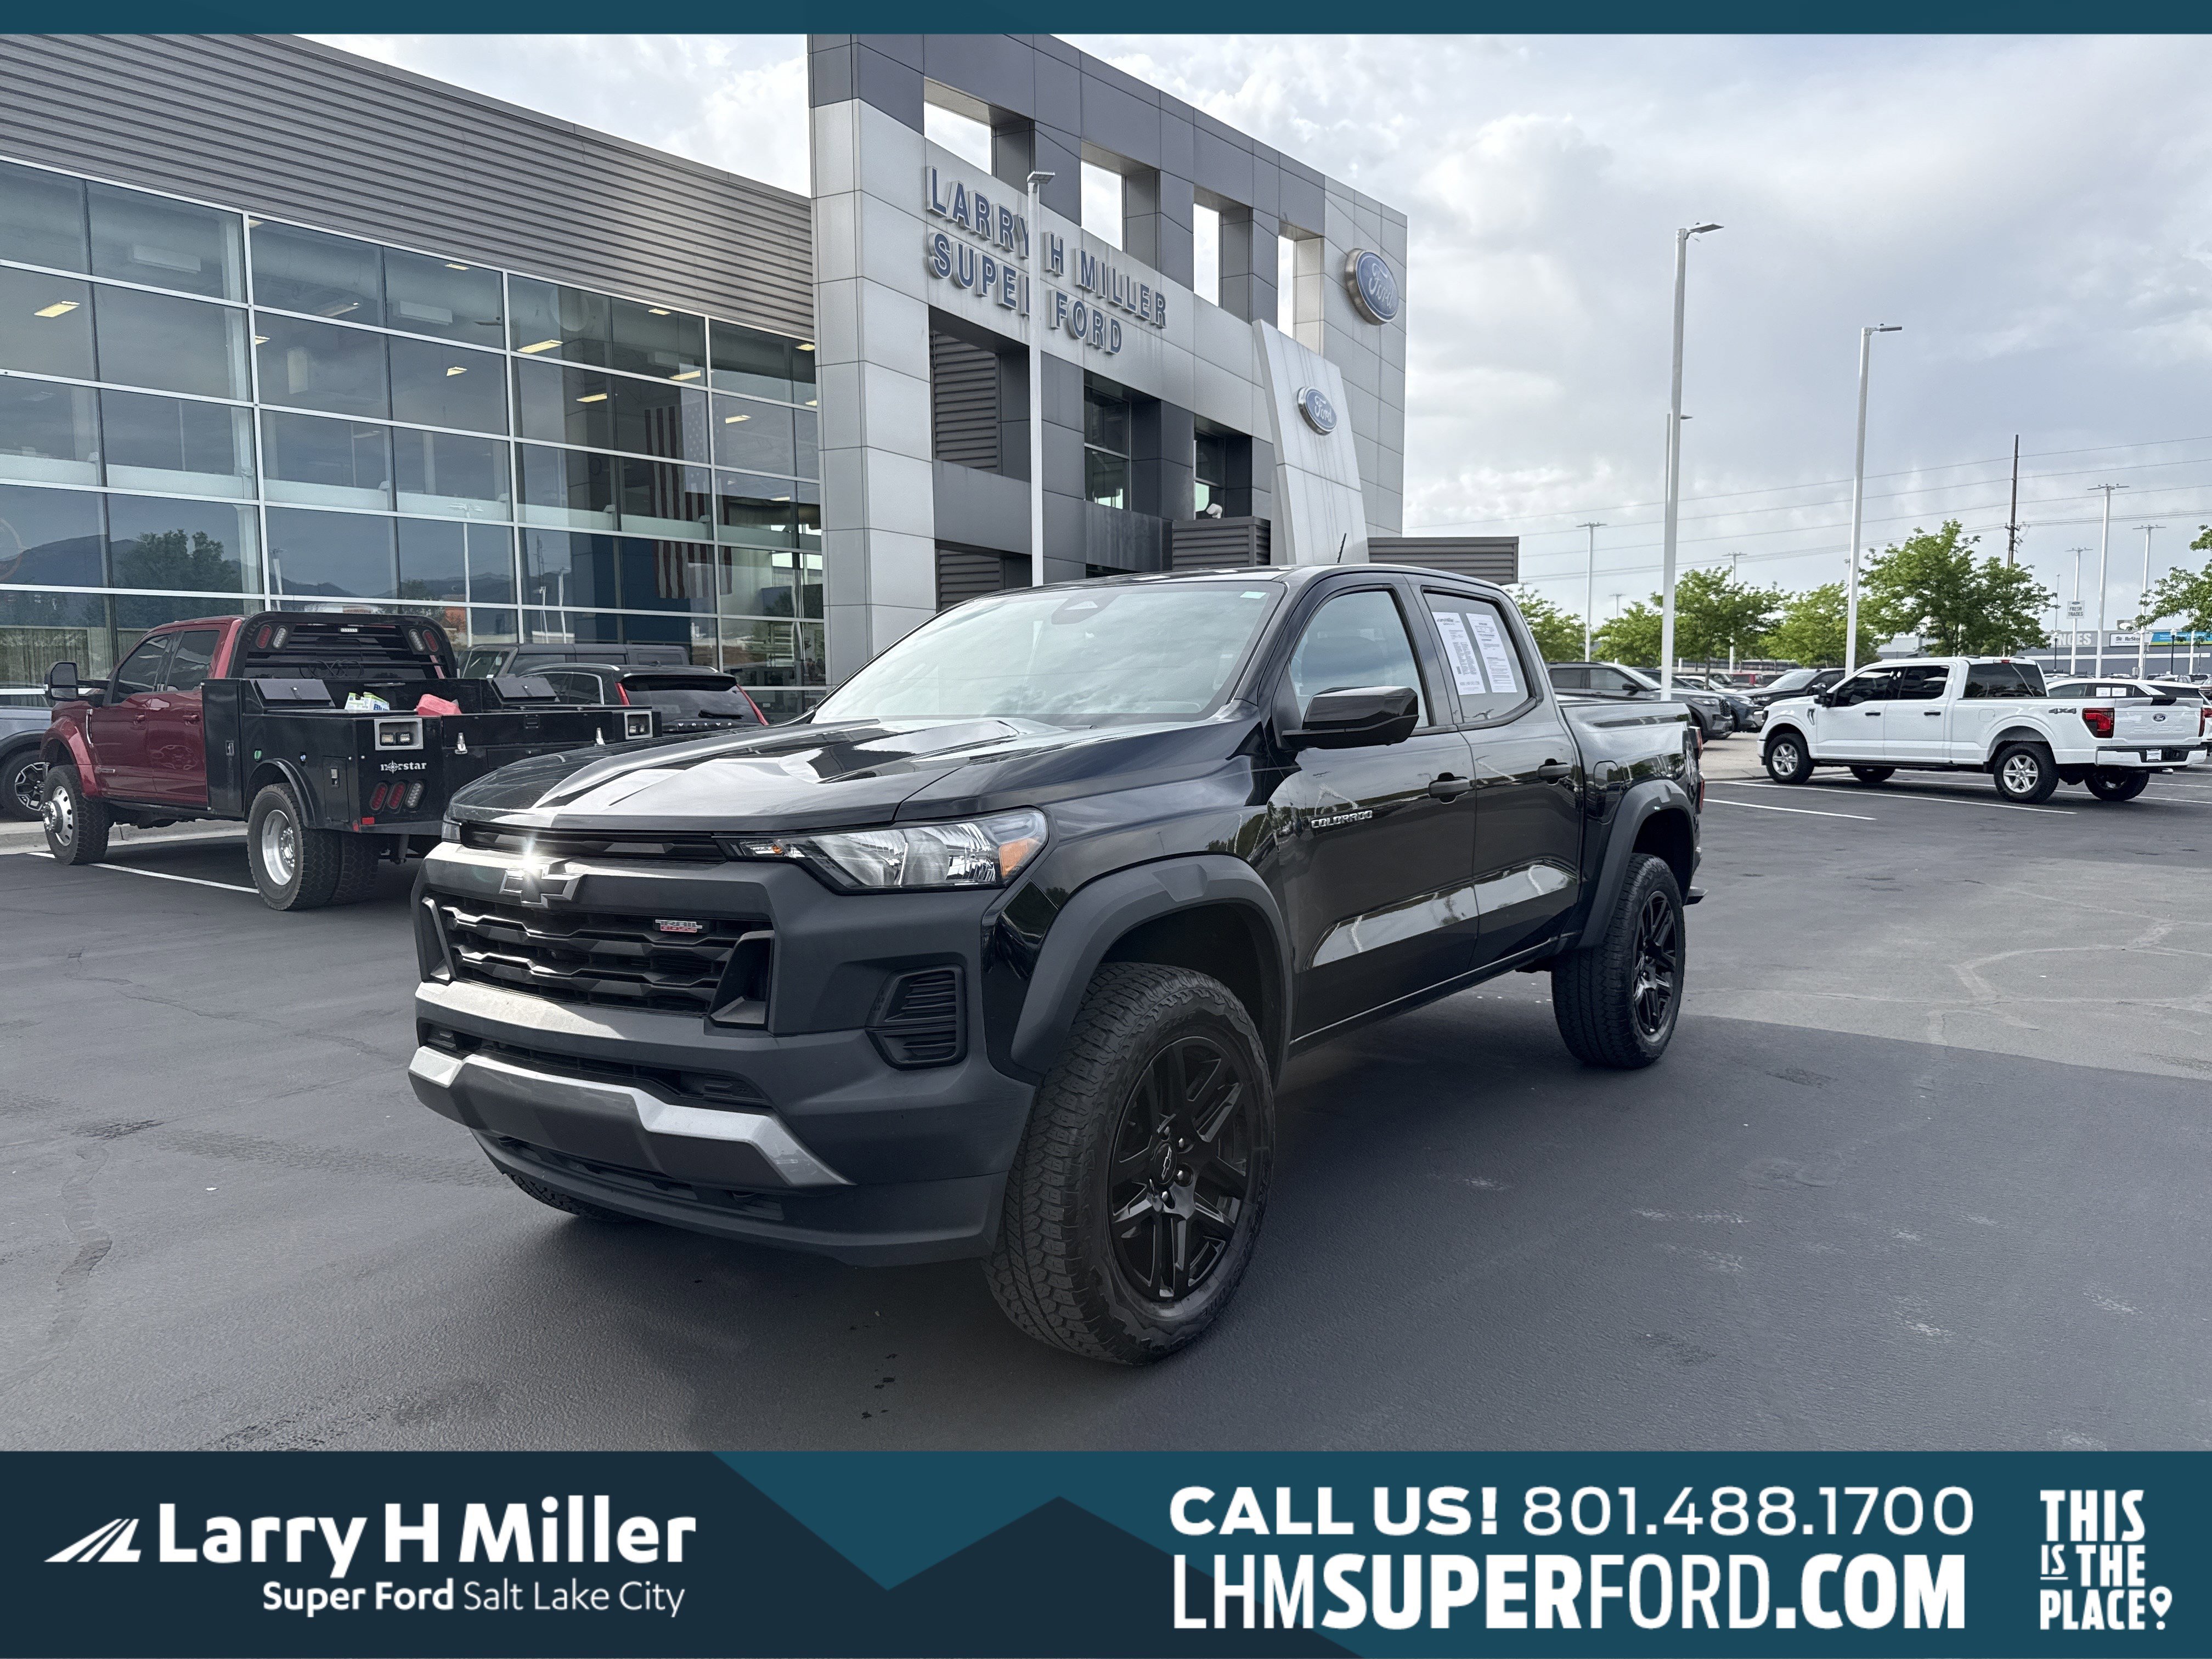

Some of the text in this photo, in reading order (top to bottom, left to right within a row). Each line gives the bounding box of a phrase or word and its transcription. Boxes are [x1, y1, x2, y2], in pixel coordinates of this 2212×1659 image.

[926, 166, 1167, 328] LARRY H MILLER
[1051, 289, 1122, 356] FORD
[1311, 810, 1373, 828] COLORADO
[655, 919, 703, 929] TRAIL
[660, 925, 697, 933] BOSS
